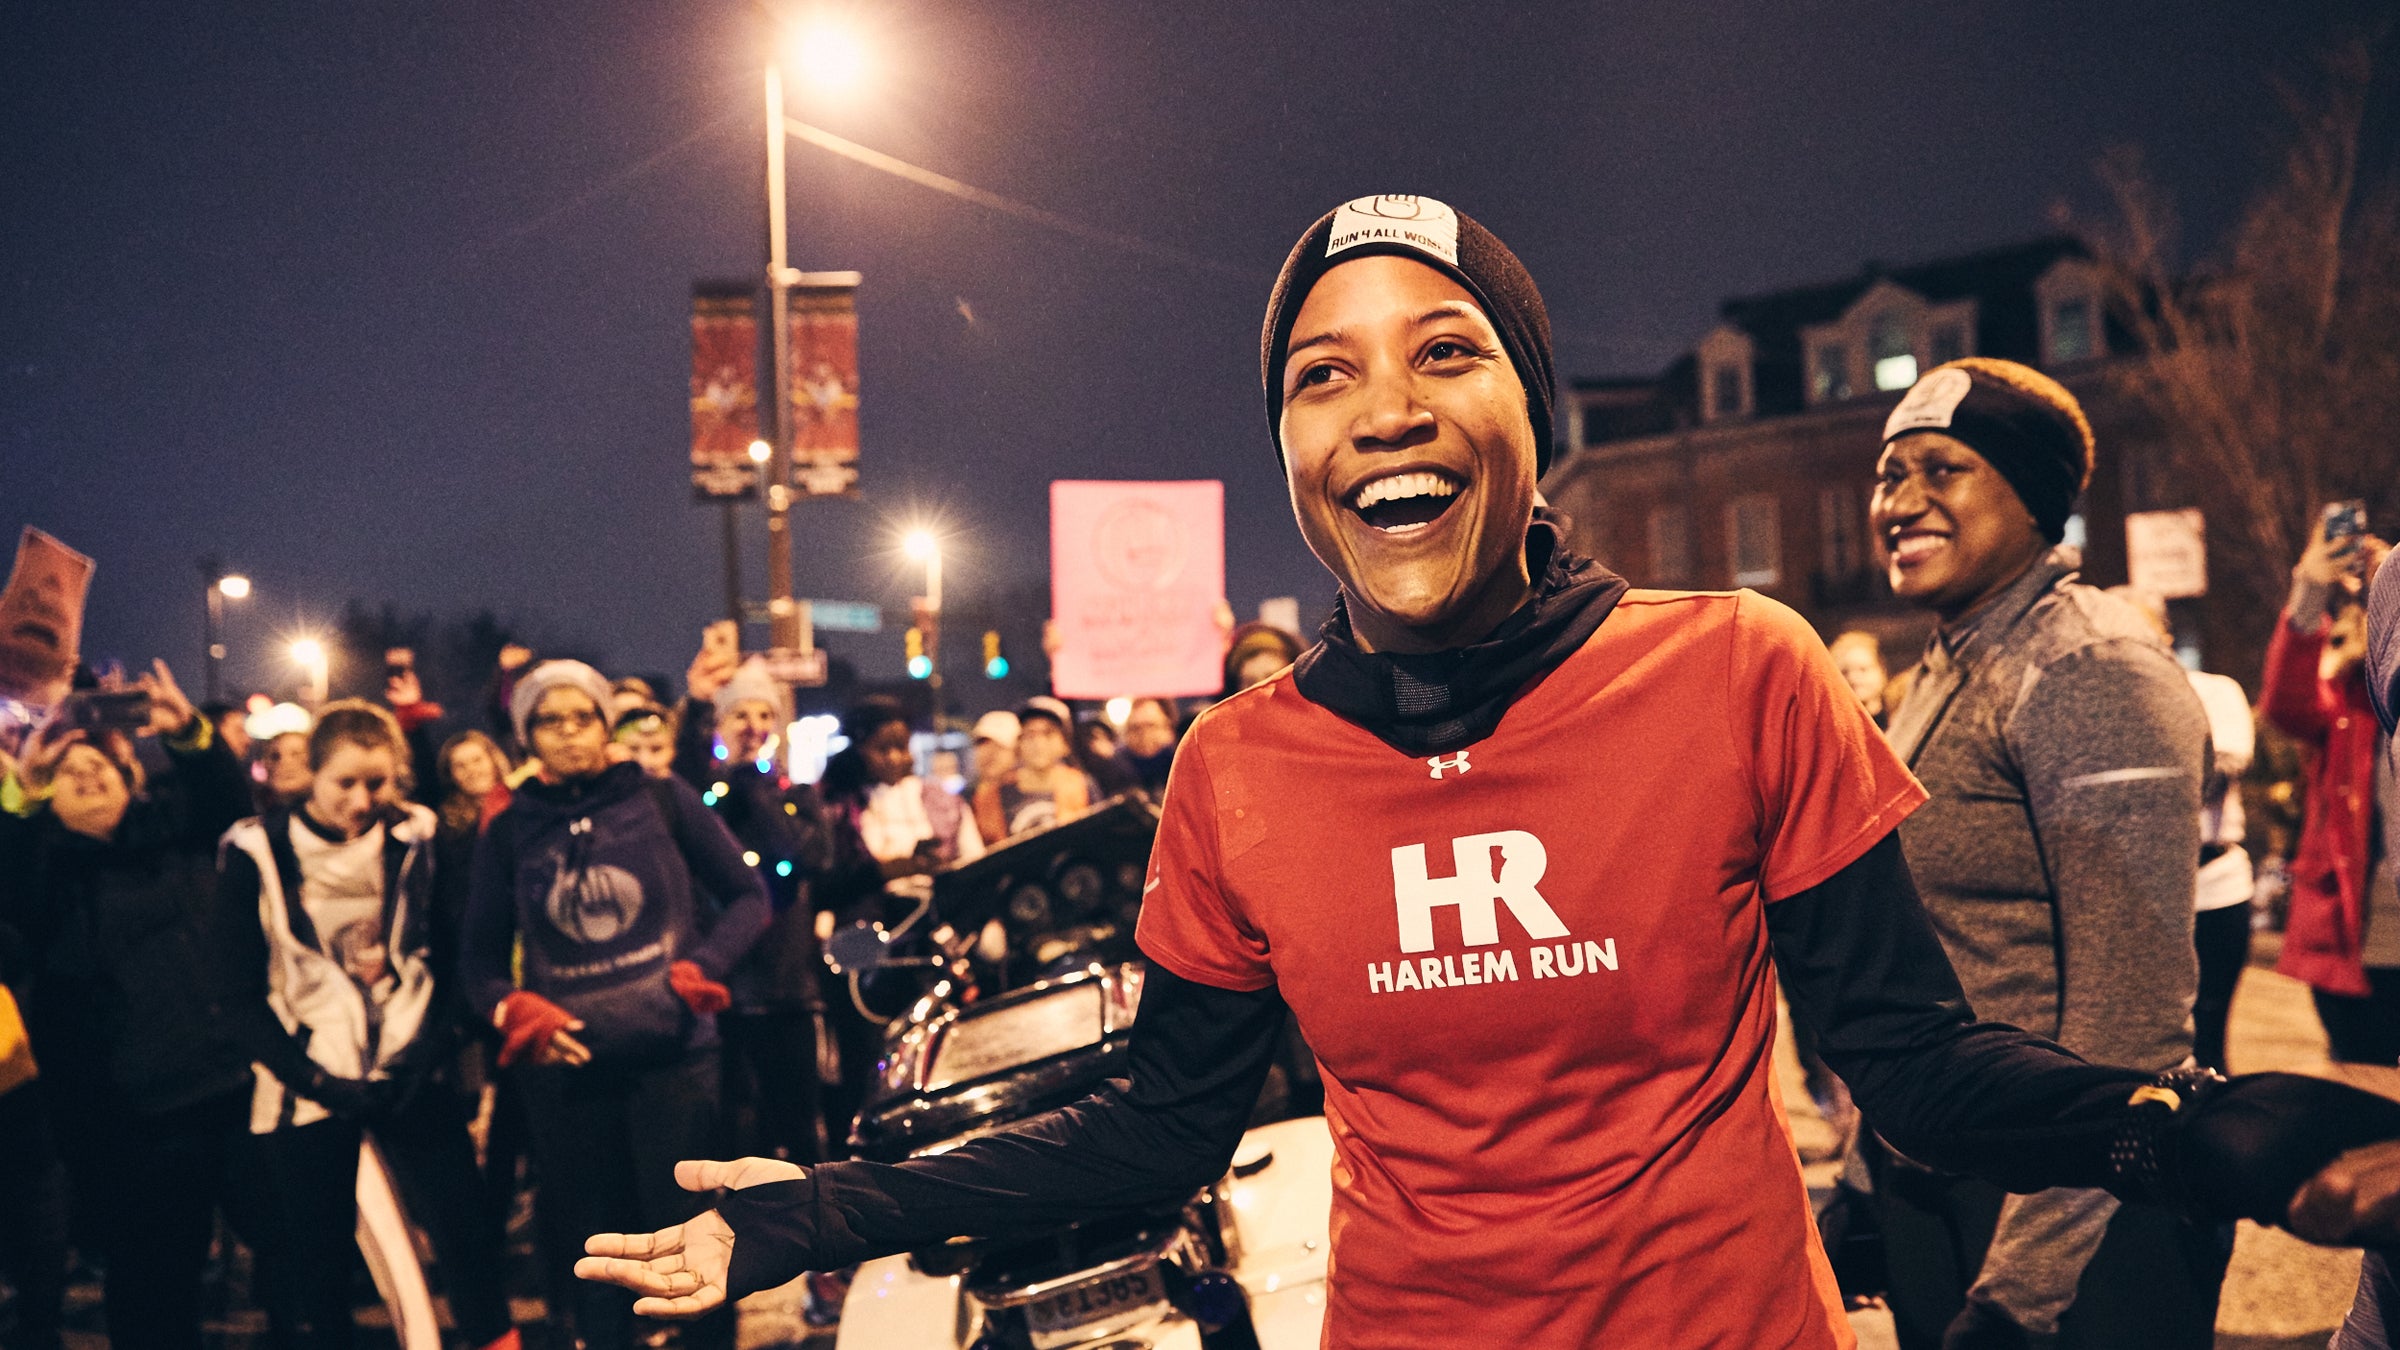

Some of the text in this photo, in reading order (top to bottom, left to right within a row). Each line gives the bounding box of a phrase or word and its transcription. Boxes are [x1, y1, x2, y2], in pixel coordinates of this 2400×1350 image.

[1331, 231, 1359, 251] RUN
[1361, 229, 1371, 239] 4
[1374, 228, 1400, 238] ALL
[1391, 830, 1571, 954] HR
[1367, 937, 1619, 993] HARLEM RUN
